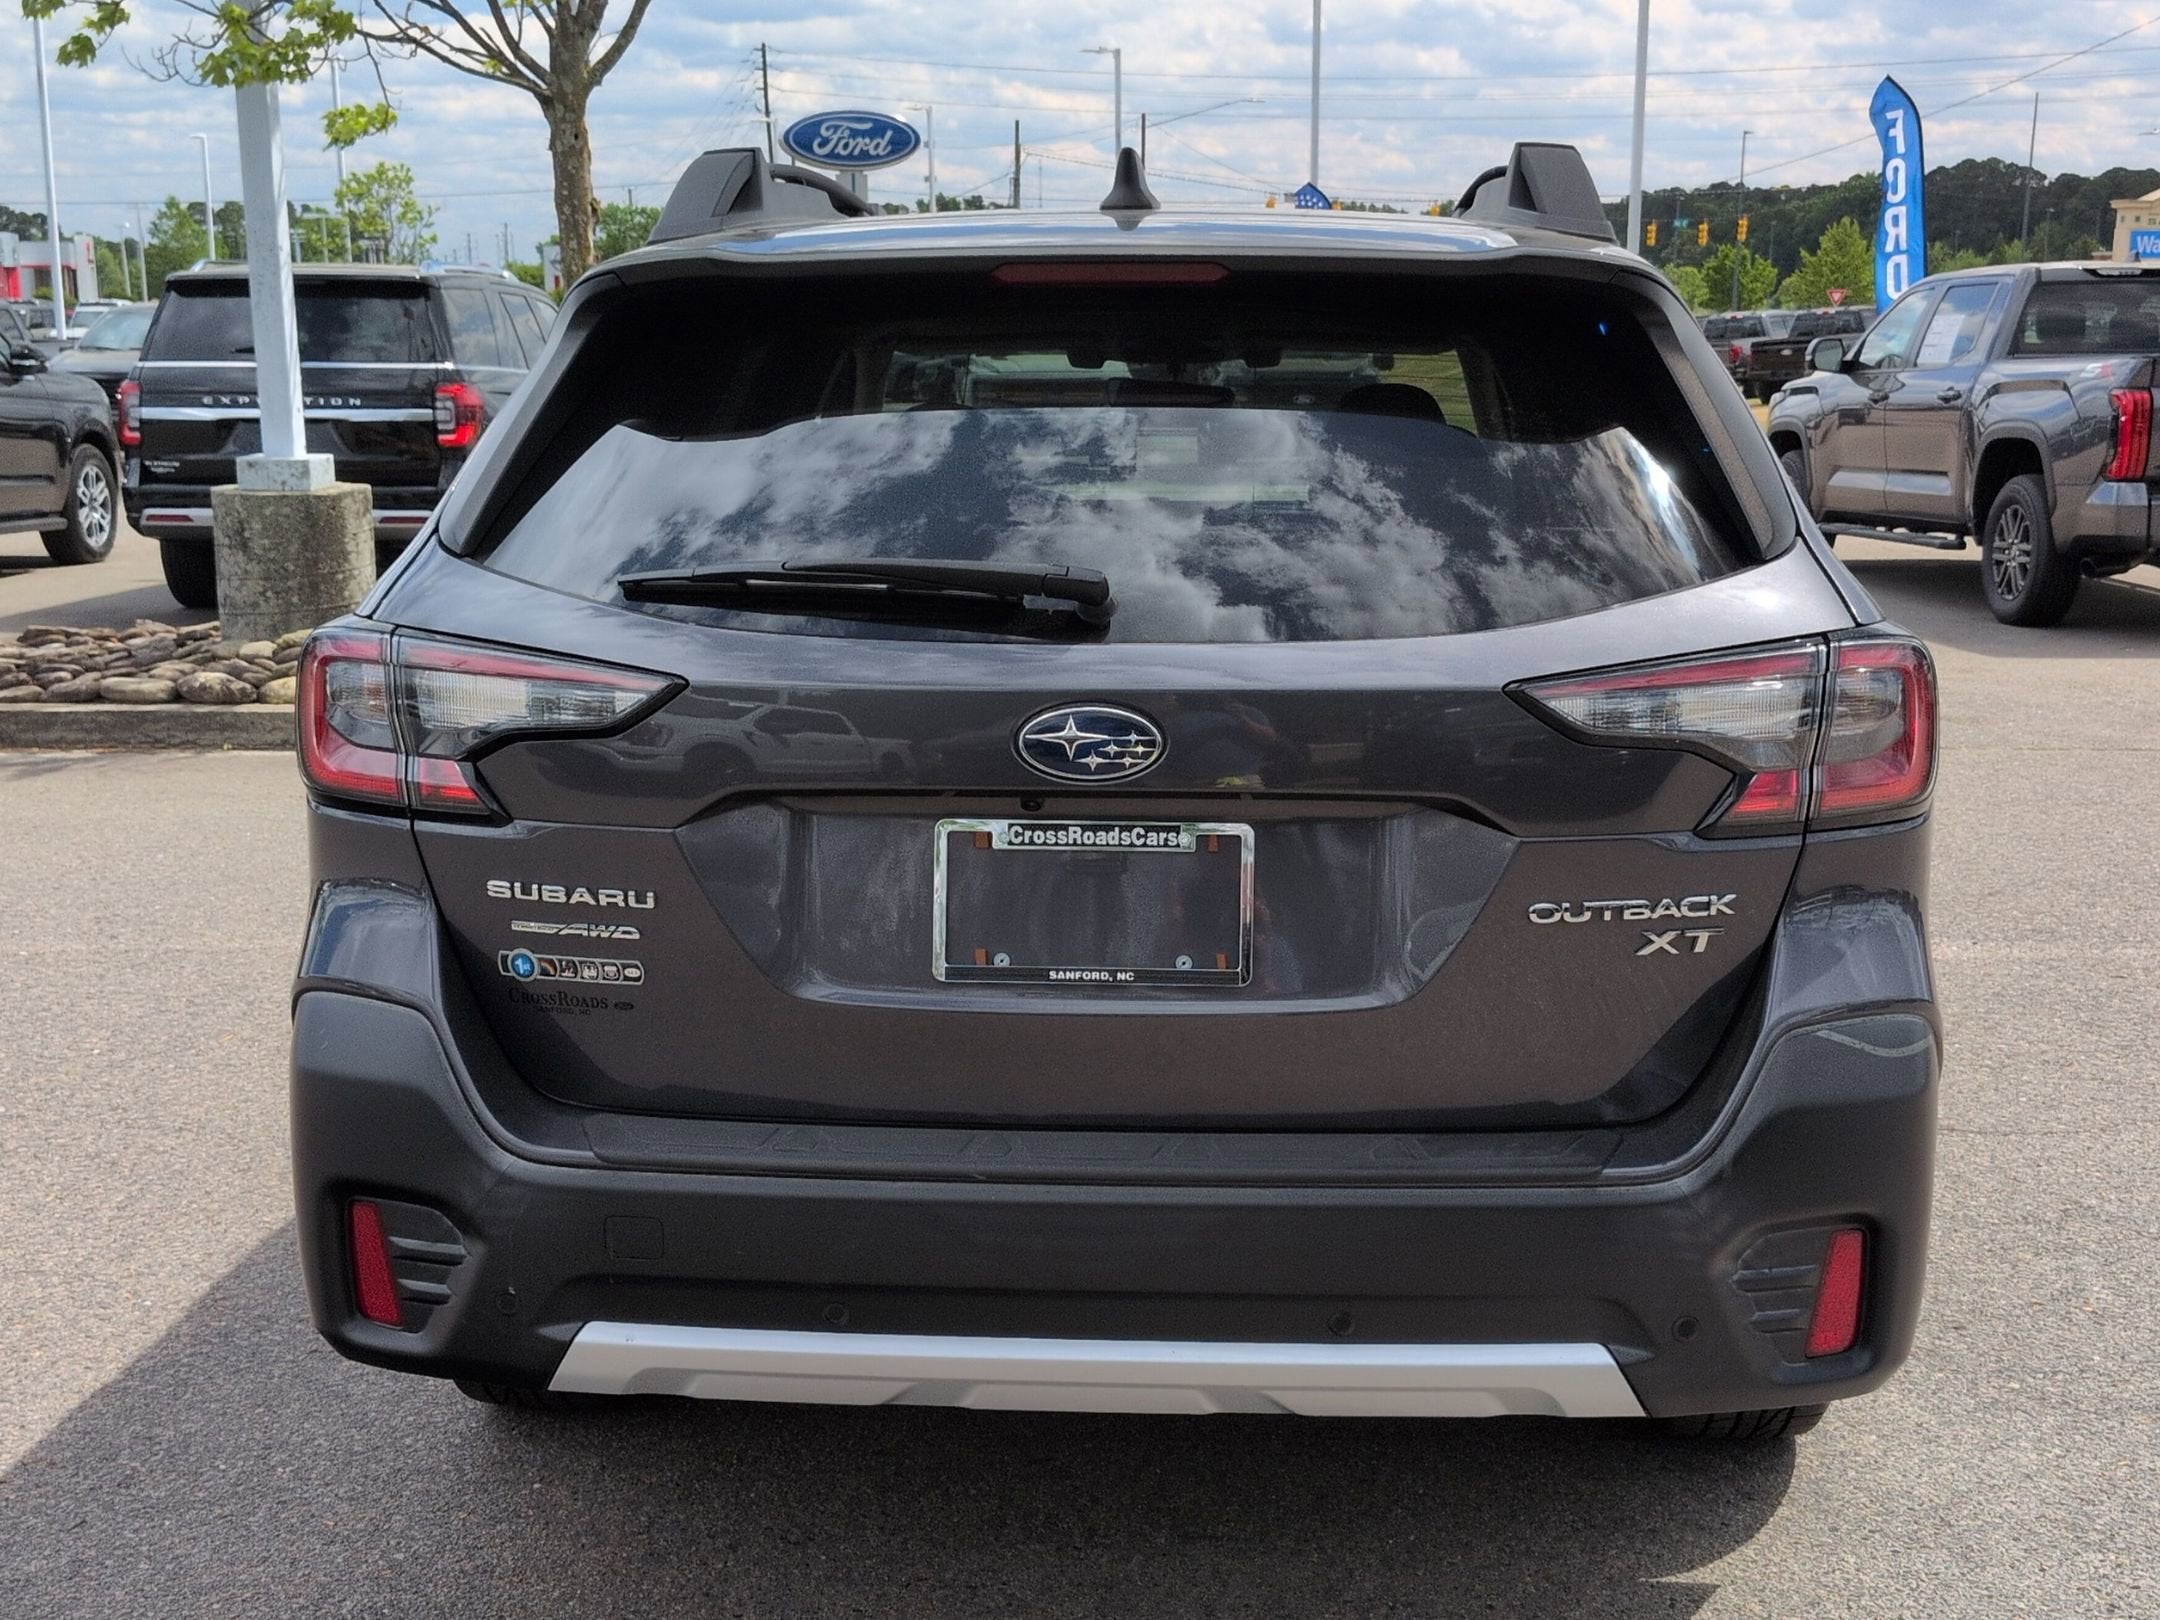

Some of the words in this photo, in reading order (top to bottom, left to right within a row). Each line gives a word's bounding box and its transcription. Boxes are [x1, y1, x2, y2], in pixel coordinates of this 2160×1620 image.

[812, 121, 894, 156] Ford
[202, 396, 362, 407] EXPTION
[1009, 825, 1179, 846] CrossRoadsCars
[486, 879, 656, 909] SUBARU
[1528, 894, 1737, 924] OUTBACK
[557, 923, 641, 940] AWD
[1635, 927, 1726, 956] XT
[1048, 970, 1113, 982] SANFORD,
[1116, 971, 1135, 981] NC
